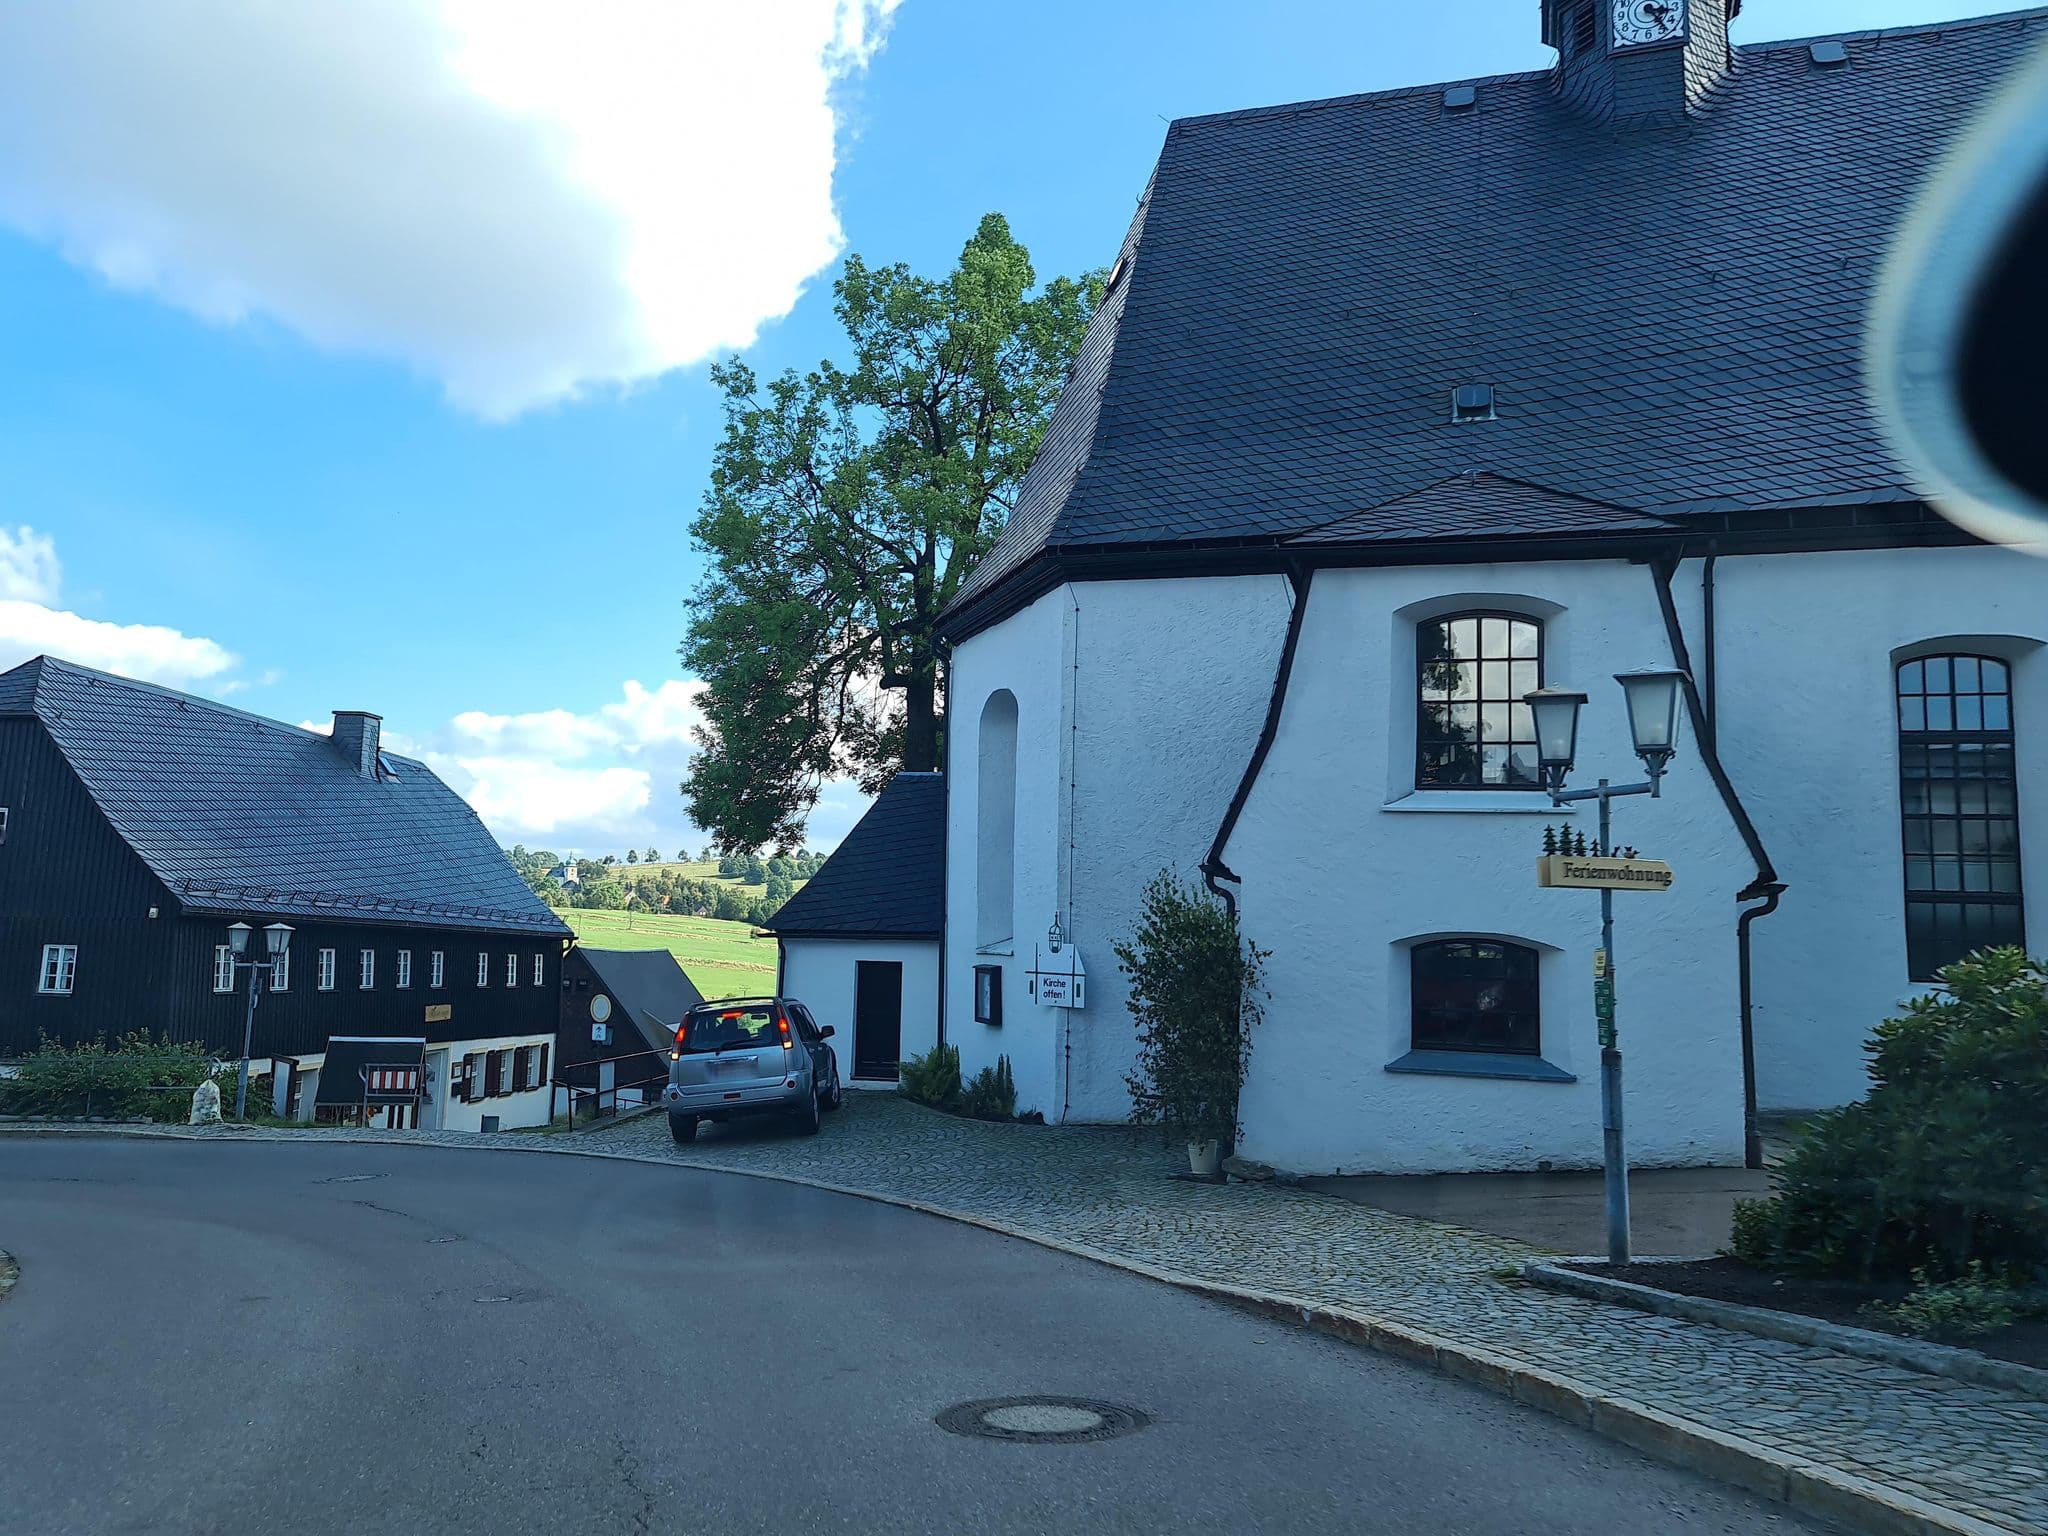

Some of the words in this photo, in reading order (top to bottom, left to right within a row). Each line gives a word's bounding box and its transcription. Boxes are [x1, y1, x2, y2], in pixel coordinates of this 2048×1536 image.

[1671, 2, 1679, 11] 3
[1618, 11, 1625, 21] 9
[1666, 15, 1675, 24] 4
[1621, 22, 1629, 32] 8
[1658, 25, 1667, 35] 5
[1632, 29, 1639, 39] 7
[1645, 29, 1652, 39] 6
[1563, 862, 1672, 886] Ferienwohnung
[1043, 977, 1066, 988] Kirche
